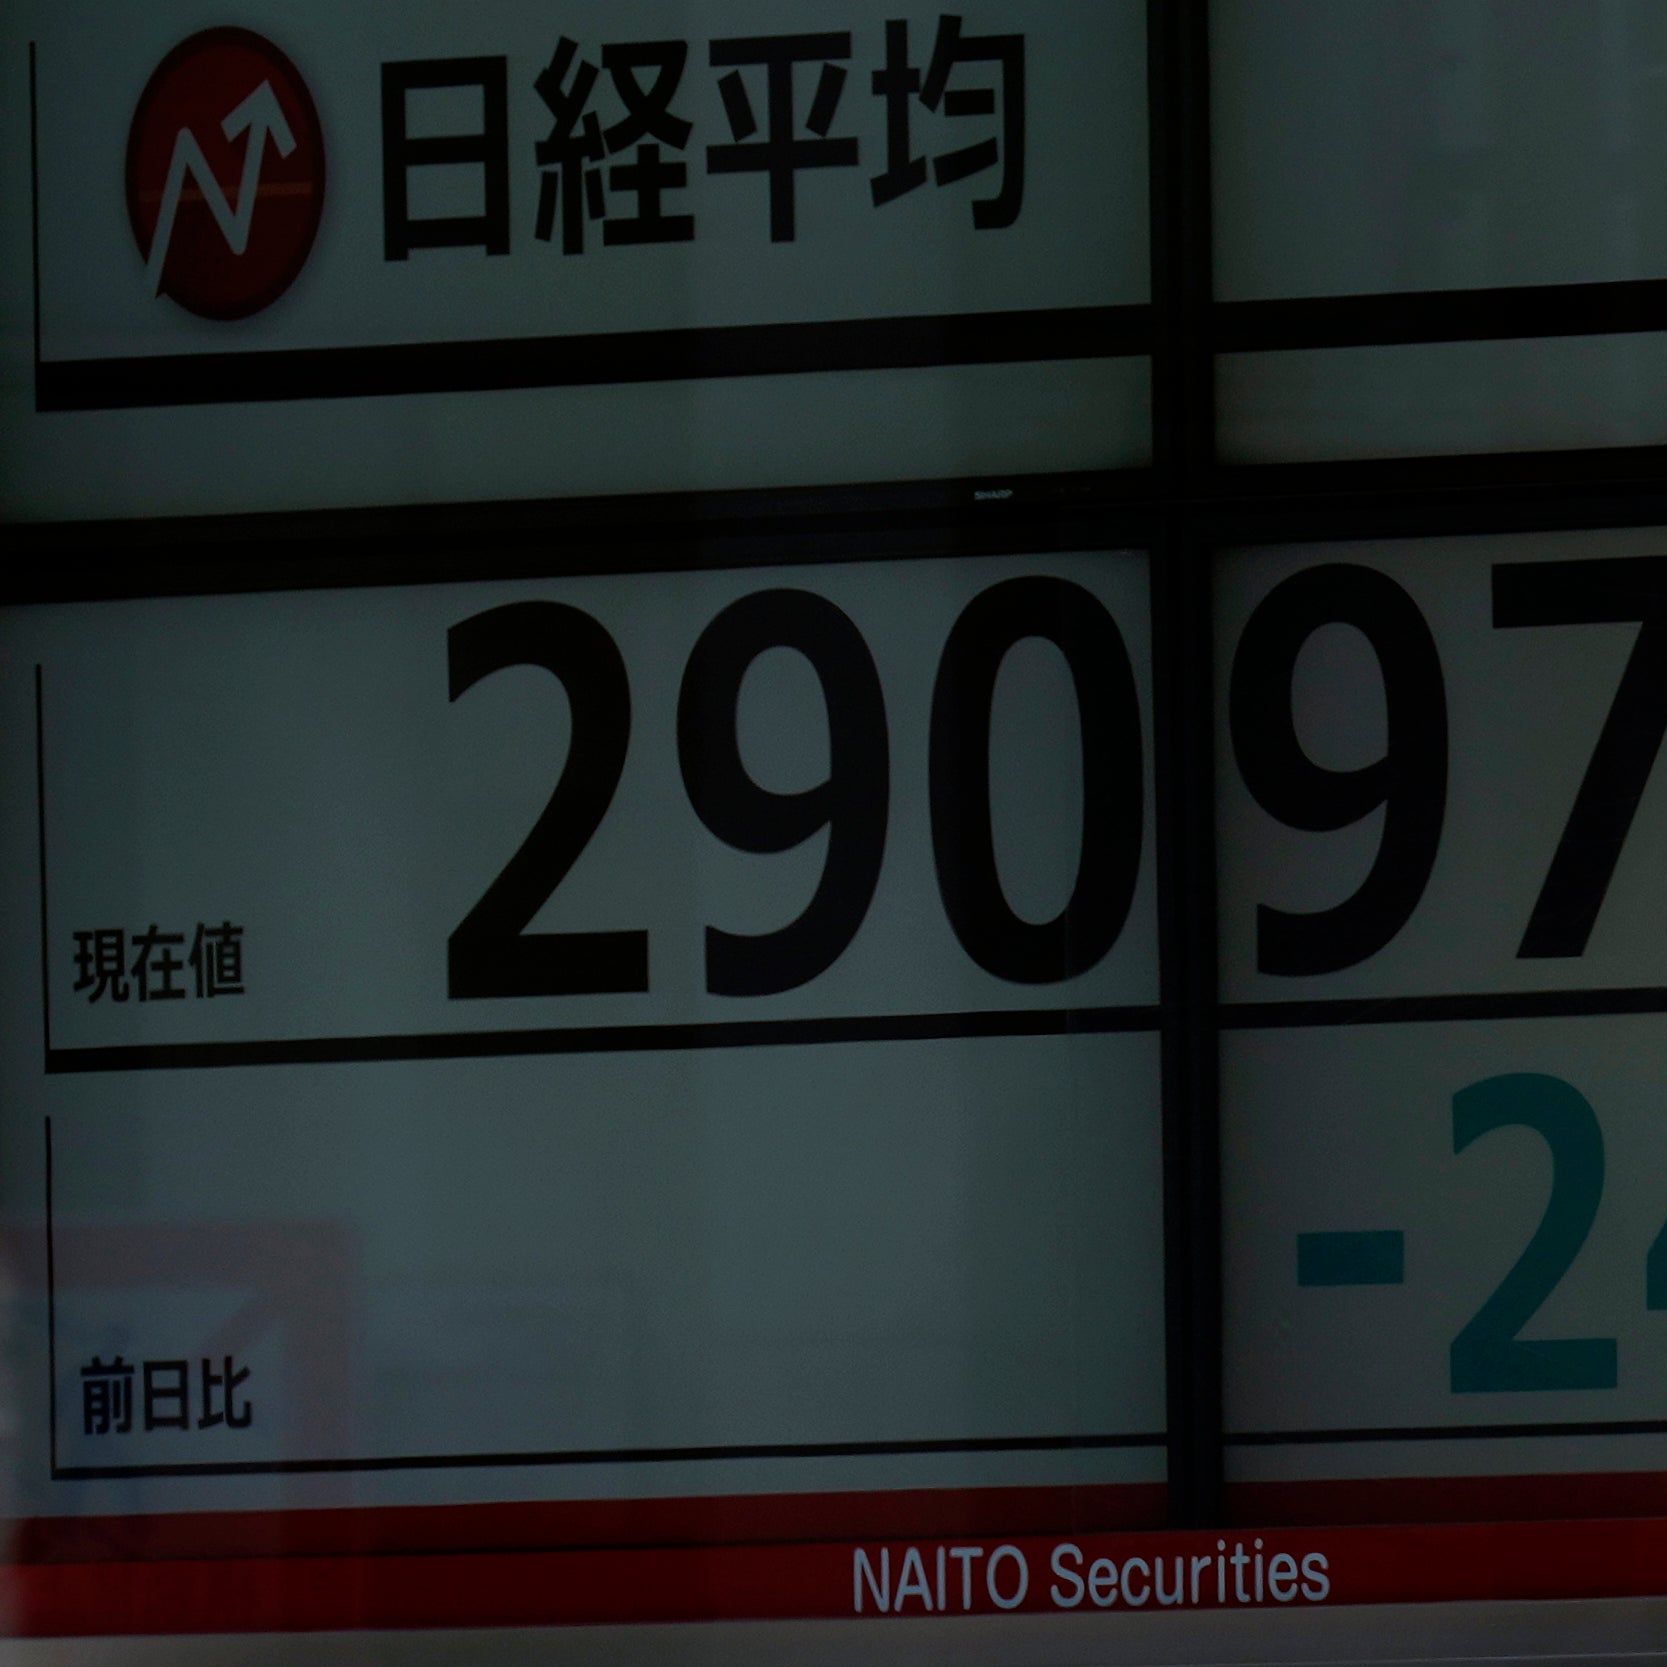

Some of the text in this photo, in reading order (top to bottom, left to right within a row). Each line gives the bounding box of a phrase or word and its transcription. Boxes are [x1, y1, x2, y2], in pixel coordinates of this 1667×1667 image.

[379, 15, 1028, 262] 日経平均
[72, 923, 246, 1004] 現在値
[81, 1355, 252, 1435] 前日比
[852, 1538, 1331, 1614] NAITO Securities
